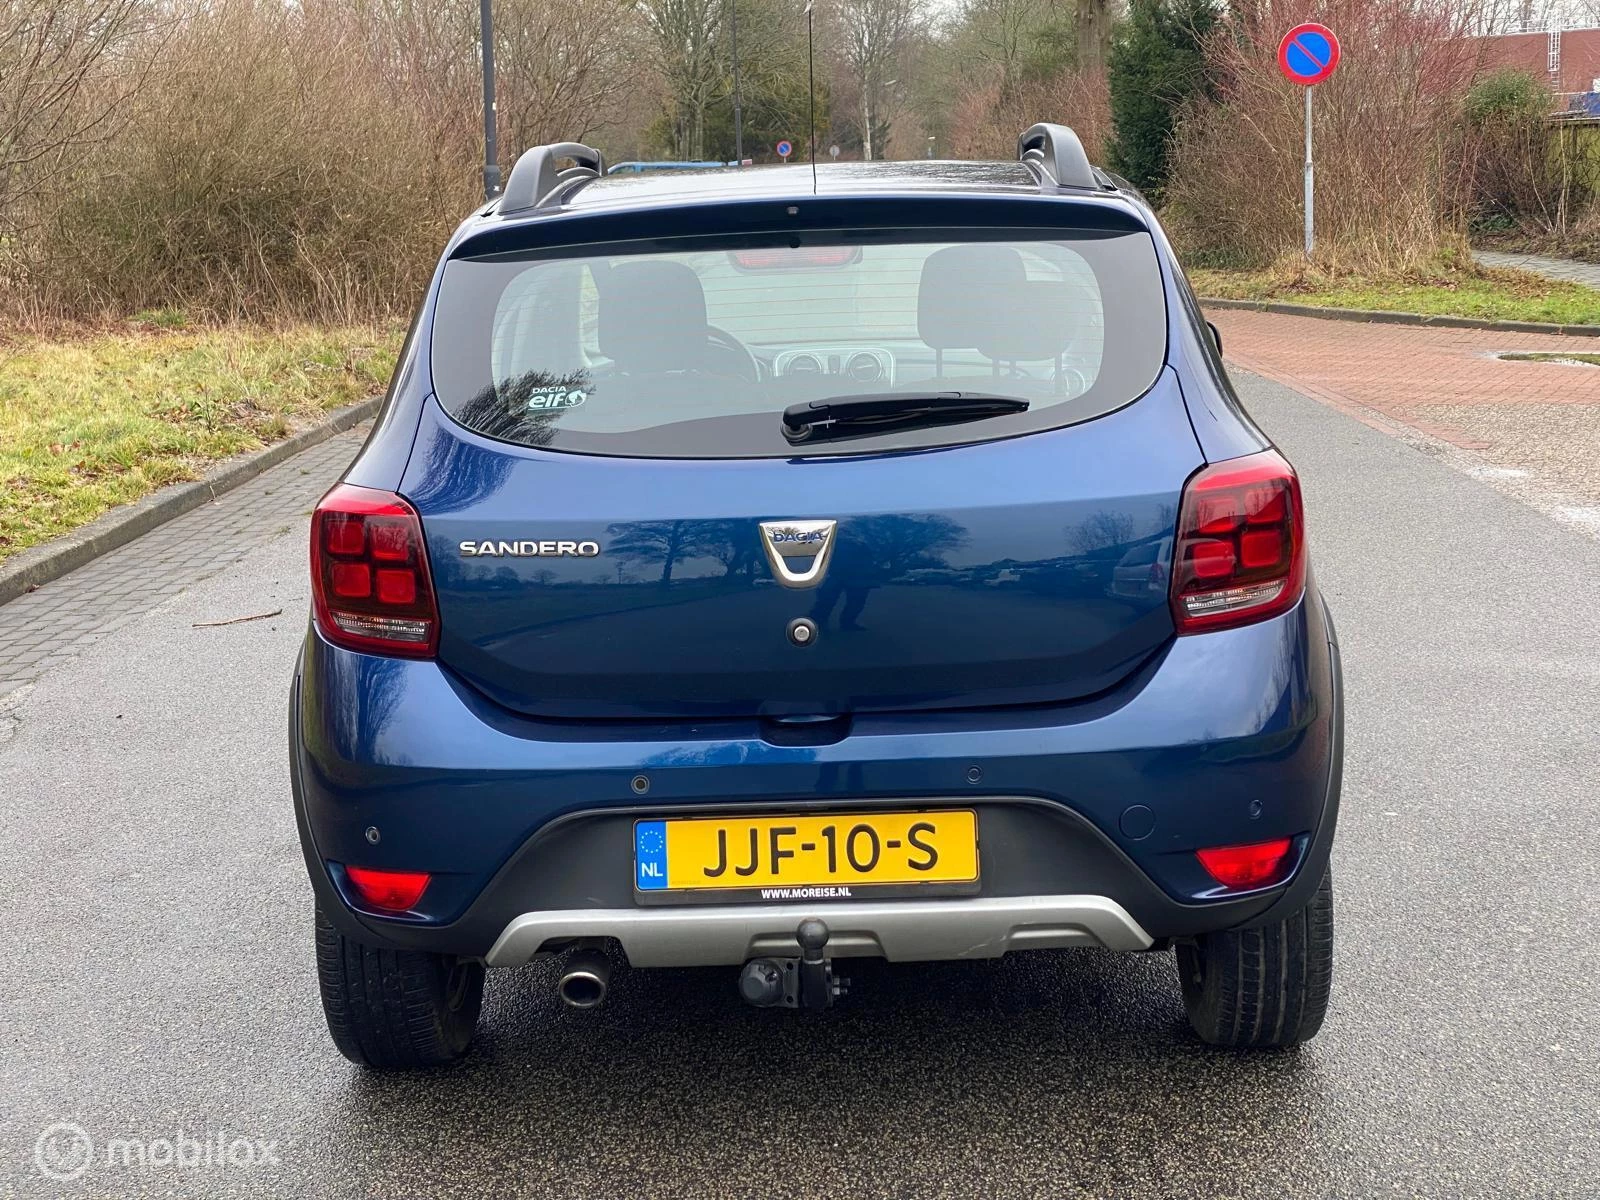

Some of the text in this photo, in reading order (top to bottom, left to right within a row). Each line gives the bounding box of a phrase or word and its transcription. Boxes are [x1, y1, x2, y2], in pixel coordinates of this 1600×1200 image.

[532, 386, 567, 394] DACIA
[528, 392, 566, 408] elf
[773, 531, 824, 542] DACIA
[459, 540, 600, 557] SANDERO
[703, 822, 939, 877] JJF-10-S
[641, 863, 664, 877] NL
[761, 886, 852, 899] WWW.MOREISE.NL
